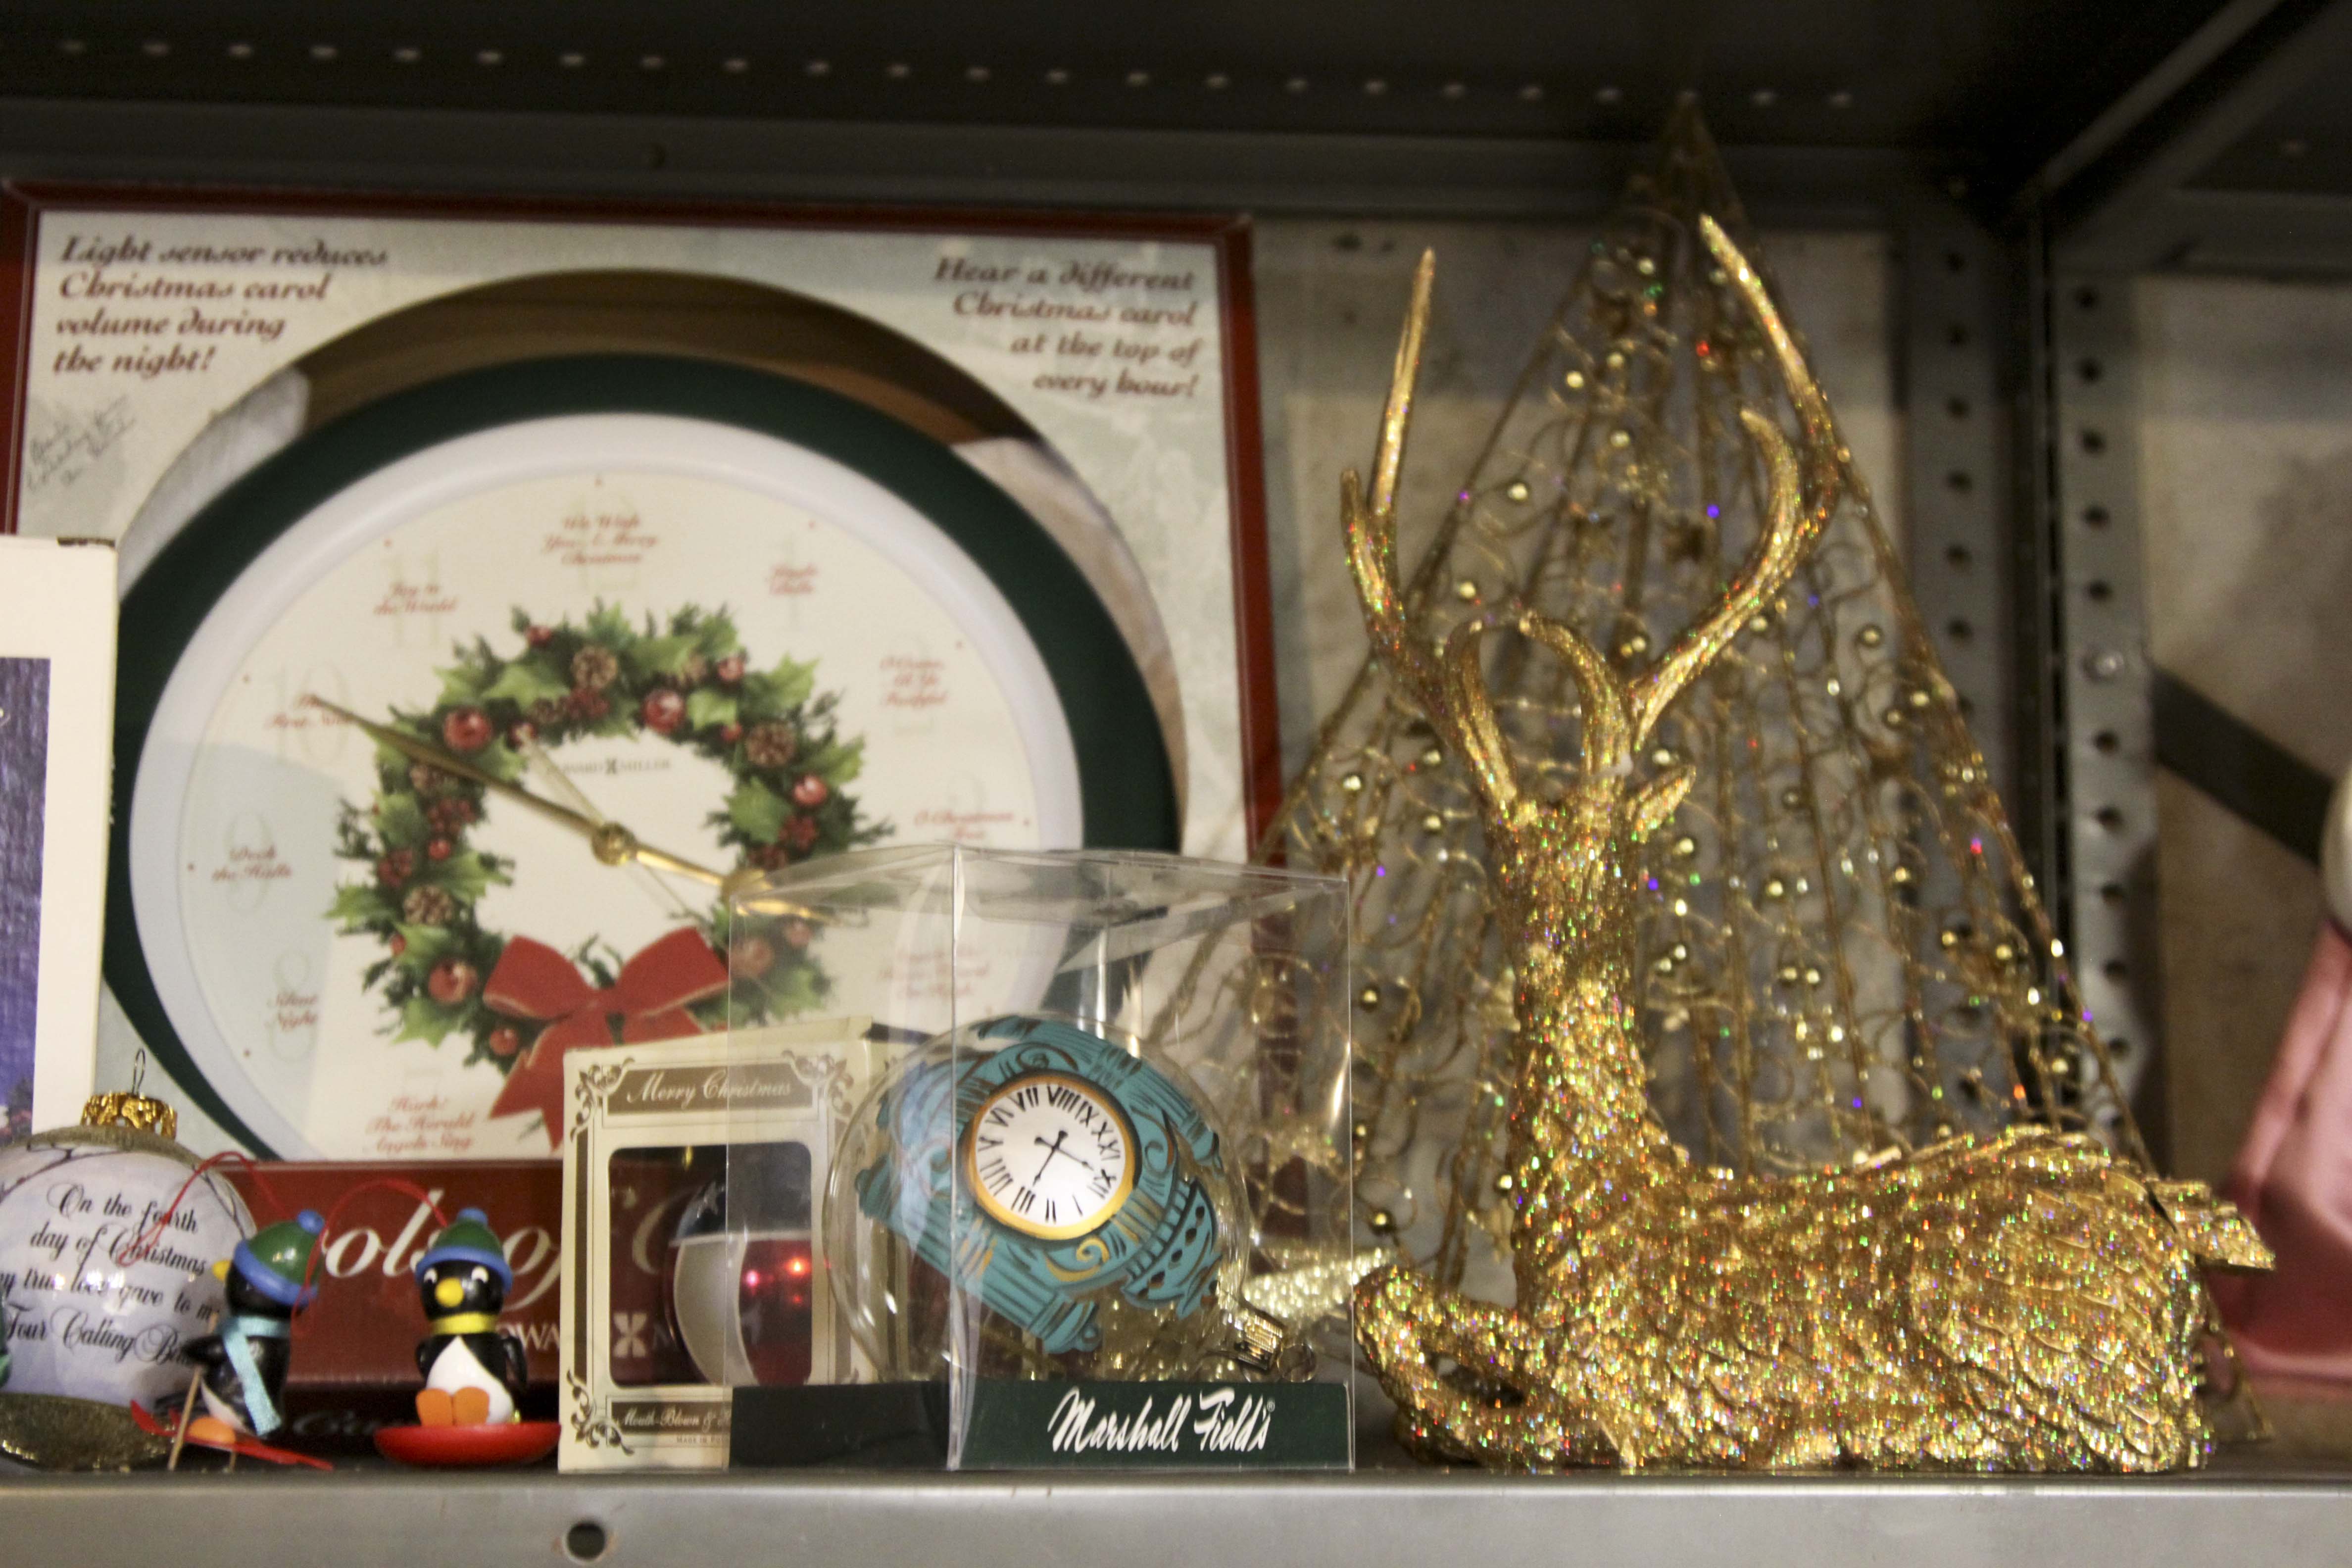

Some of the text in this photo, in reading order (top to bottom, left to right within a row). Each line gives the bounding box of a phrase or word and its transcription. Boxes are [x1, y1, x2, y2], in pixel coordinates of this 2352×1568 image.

[60, 234, 388, 269] Light sensor reduces
[59, 267, 332, 299] Christmas carol
[934, 256, 1194, 292] Hear a different
[57, 306, 286, 342] volume during
[952, 291, 1197, 326] Christmas carol
[53, 343, 217, 379] the night!
[1010, 331, 1203, 368] at the top of
[1033, 367, 1198, 398] every hour!
[626, 1068, 791, 1110] Merry Christmas
[47, 1183, 93, 1220] On
[103, 1193, 132, 1217] the
[30, 1220, 69, 1261] day
[99, 1224, 207, 1276] Christmas
[118, 1284, 164, 1310] gave
[174, 1291, 191, 1314] to
[50, 1304, 135, 1363] Calling
[1046, 1386, 1192, 1454] Marshall
